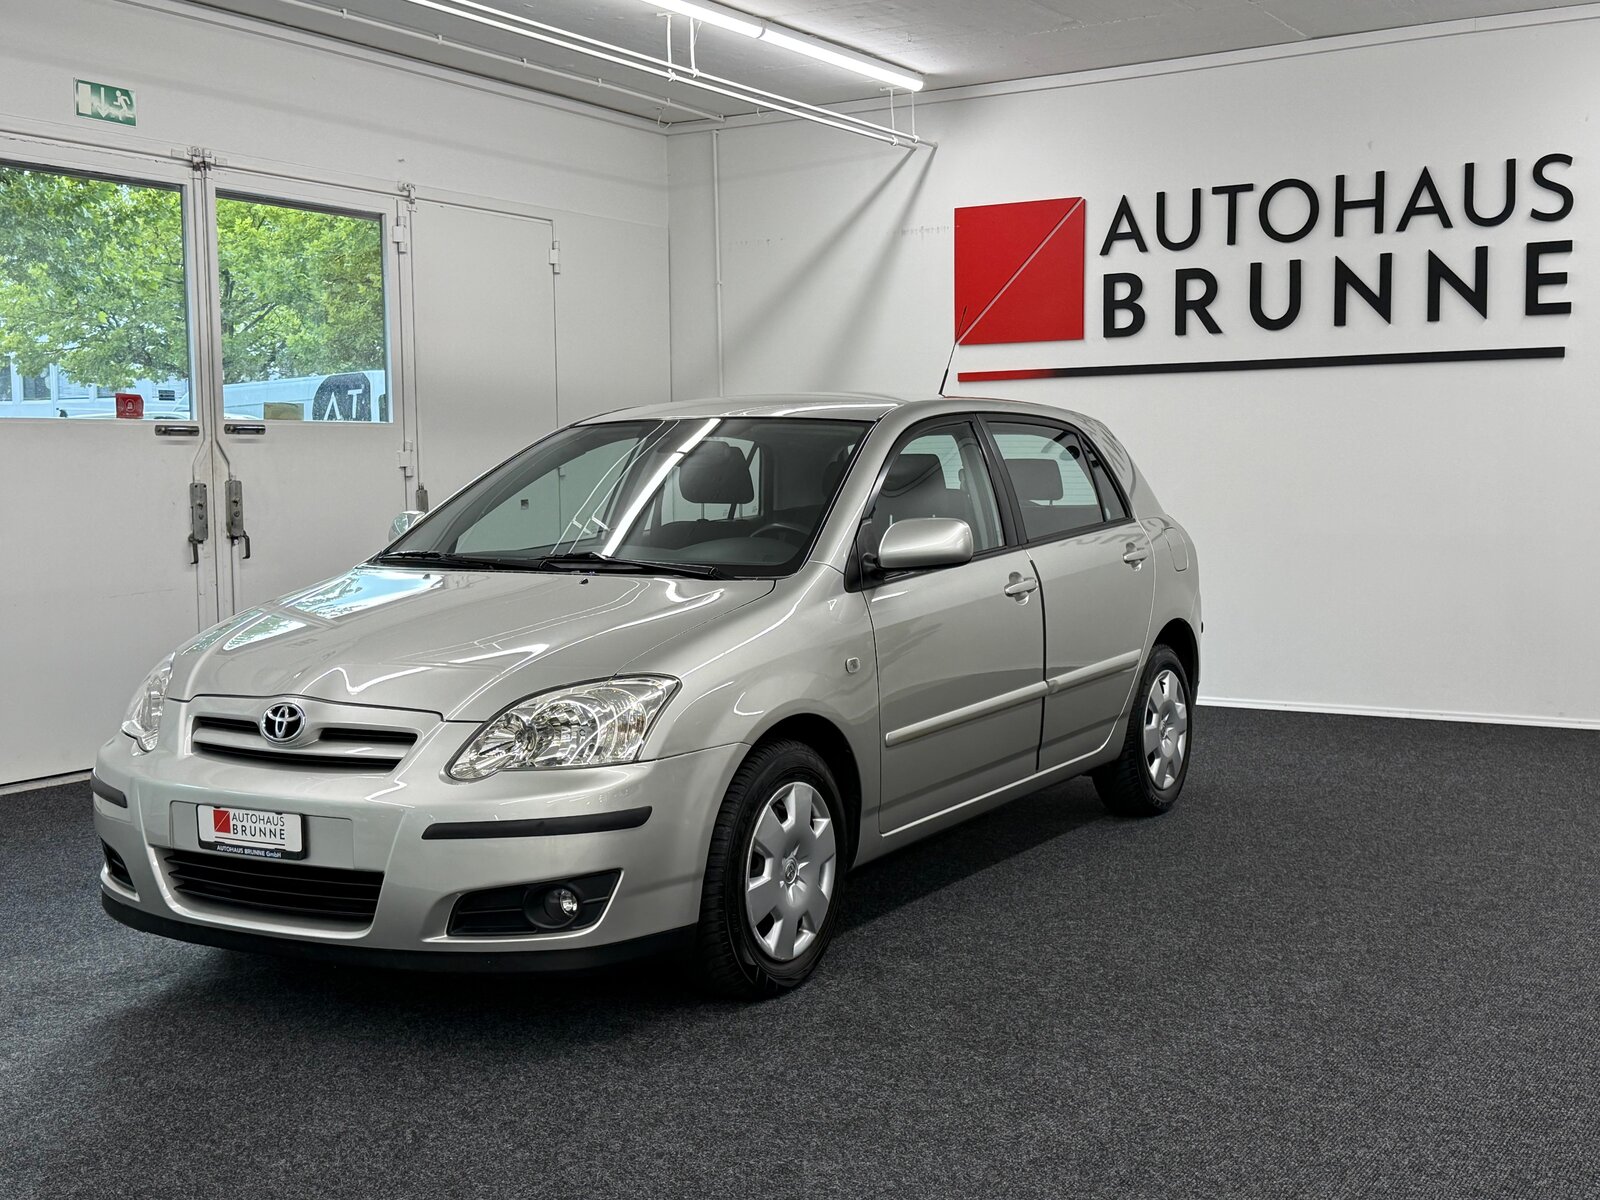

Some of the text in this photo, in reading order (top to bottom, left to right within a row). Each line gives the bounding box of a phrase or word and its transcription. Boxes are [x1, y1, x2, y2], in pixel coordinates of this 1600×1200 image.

[1100, 153, 1574, 256] AUTOHAUS
[1103, 240, 1573, 339] BRUNNE
[232, 813, 285, 827] AUTOHAUS
[232, 823, 286, 840] BRUNNE
[217, 845, 244, 853] AUTOHAUS
[244, 848, 265, 856] BRUNNE
